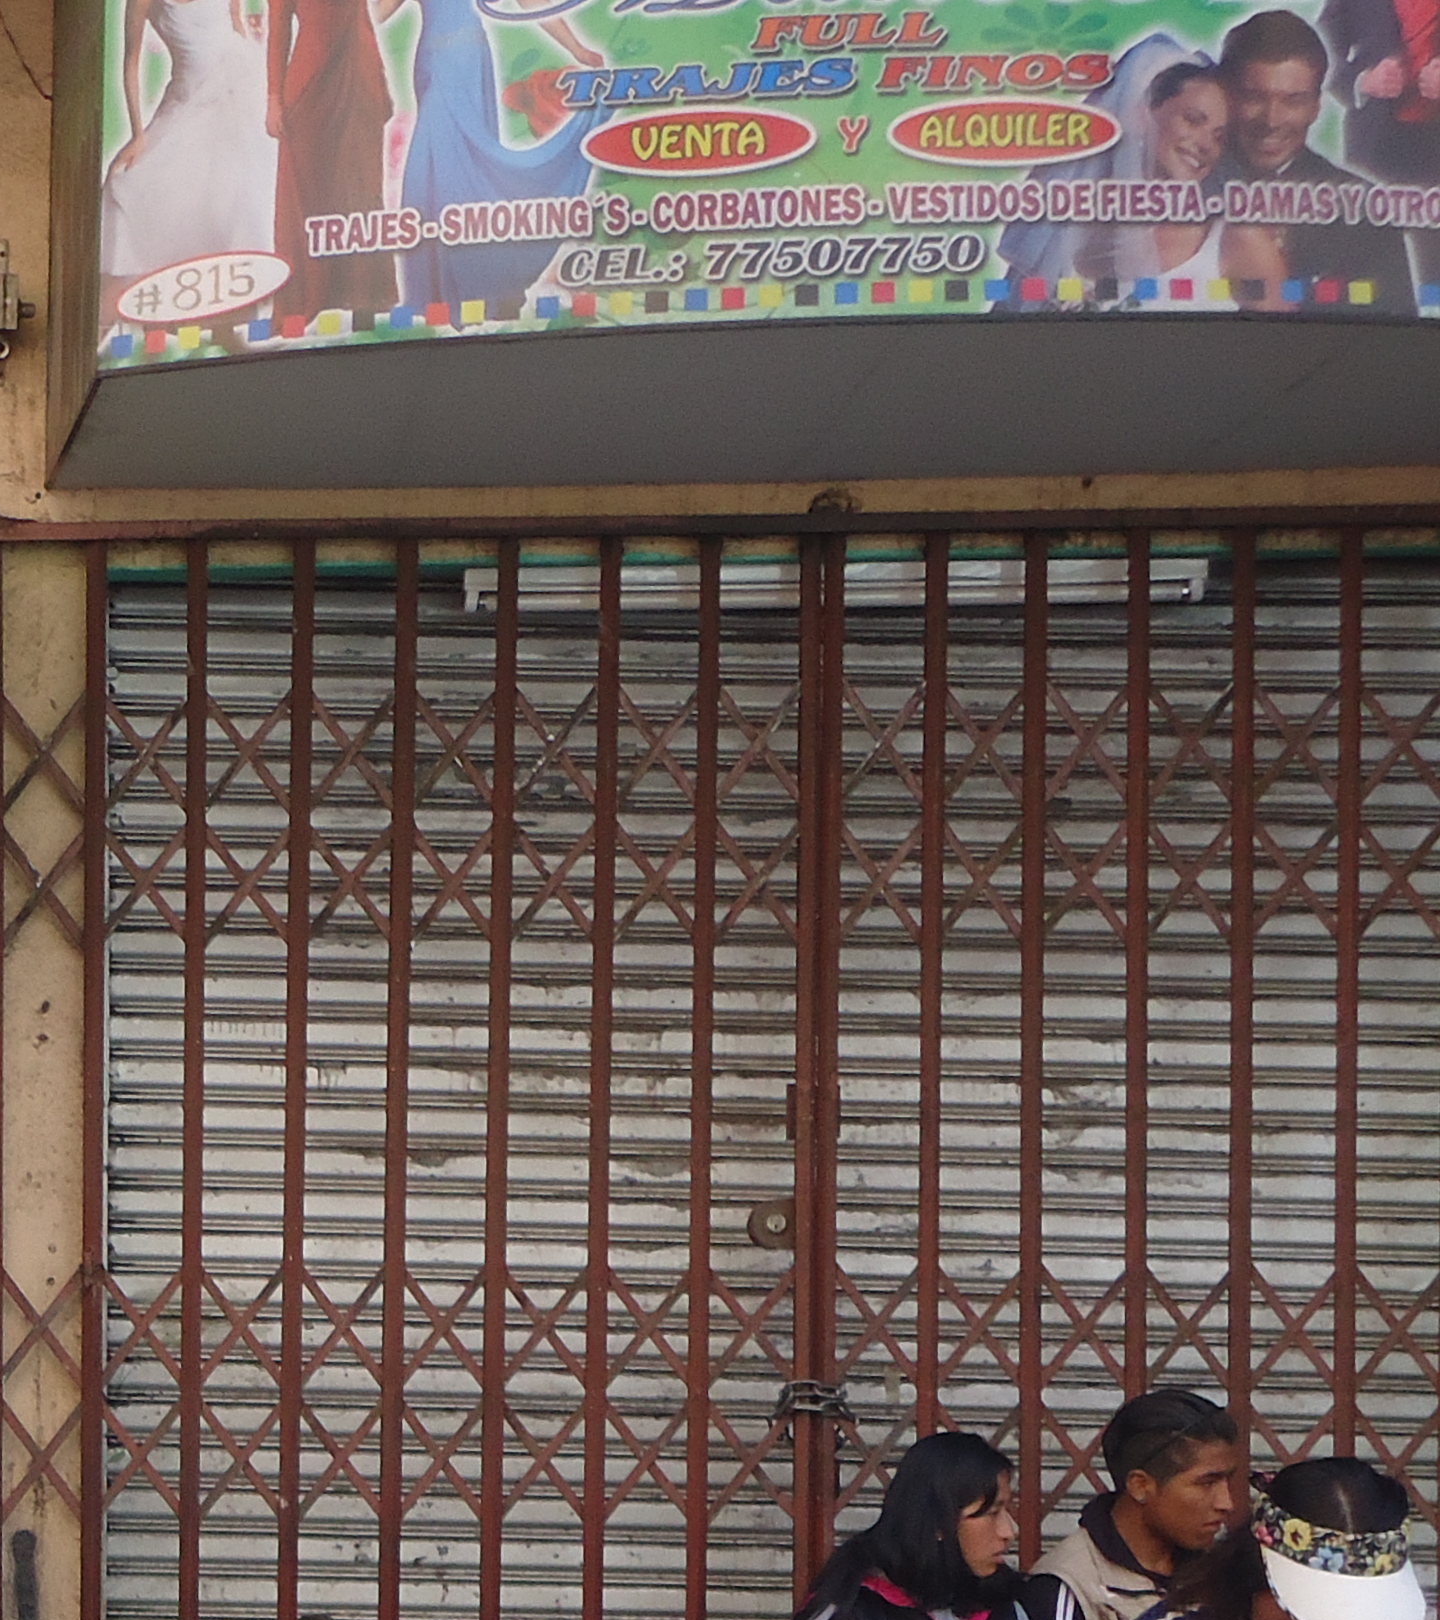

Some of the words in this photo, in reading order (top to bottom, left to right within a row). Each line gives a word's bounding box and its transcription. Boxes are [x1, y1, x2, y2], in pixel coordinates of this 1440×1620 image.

[752, 12, 948, 52] FULL
[561, 57, 858, 105] TRAJES
[876, 53, 1114, 91] FINOS
[630, 120, 766, 161] VENTA
[838, 116, 870, 153] Y
[918, 112, 1091, 149] ALQUILER
[307, 210, 418, 256] TRAJES
[651, 184, 863, 232] CORBATONES
[888, 181, 1045, 224] VESTIDOS
[1050, 182, 1096, 220] DE
[1099, 181, 1204, 222] FIESTA
[1224, 182, 1337, 224] DAMAS
[1339, 184, 1363, 224] Y
[705, 234, 984, 281] 77507750
